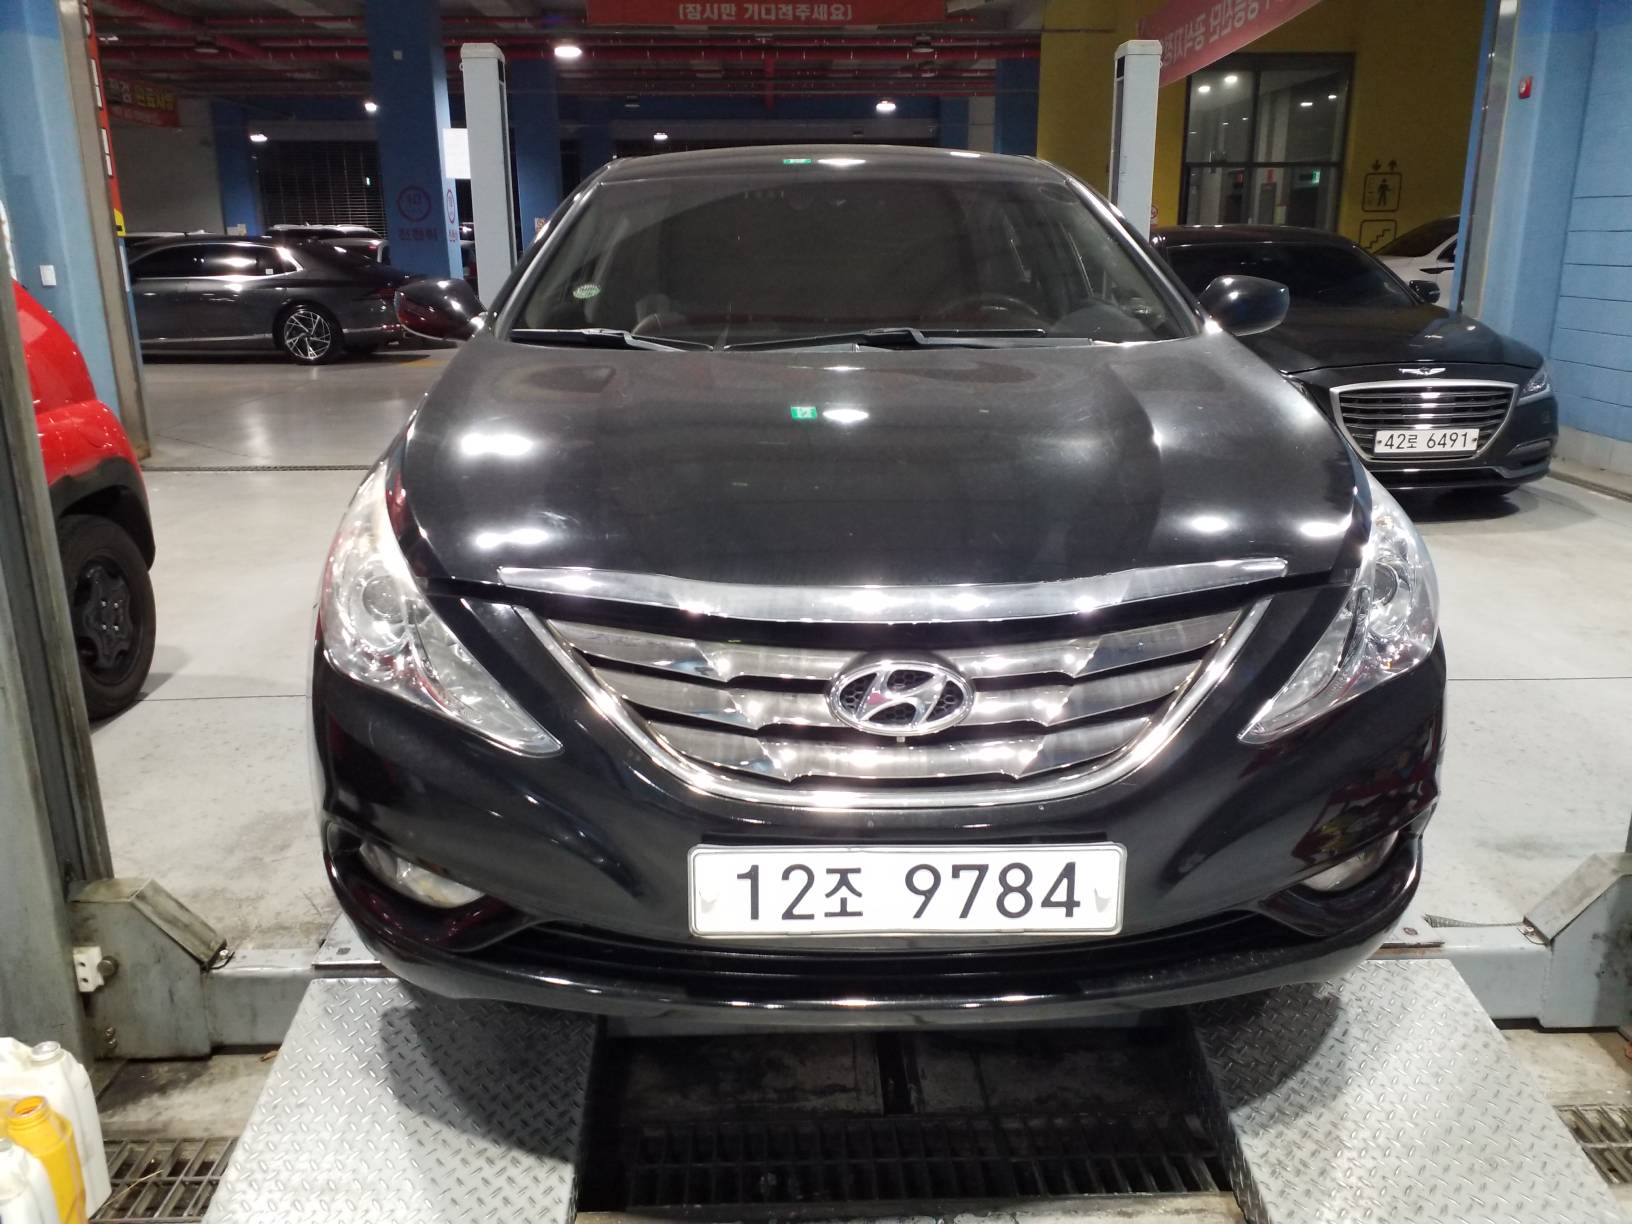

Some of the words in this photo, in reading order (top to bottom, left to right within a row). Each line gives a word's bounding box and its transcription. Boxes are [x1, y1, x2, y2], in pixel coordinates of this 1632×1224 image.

[1384, 433, 1418, 450] 42로
[1426, 431, 1468, 449] 6491
[737, 864, 863, 920] 12조
[904, 861, 1081, 919] 9784
